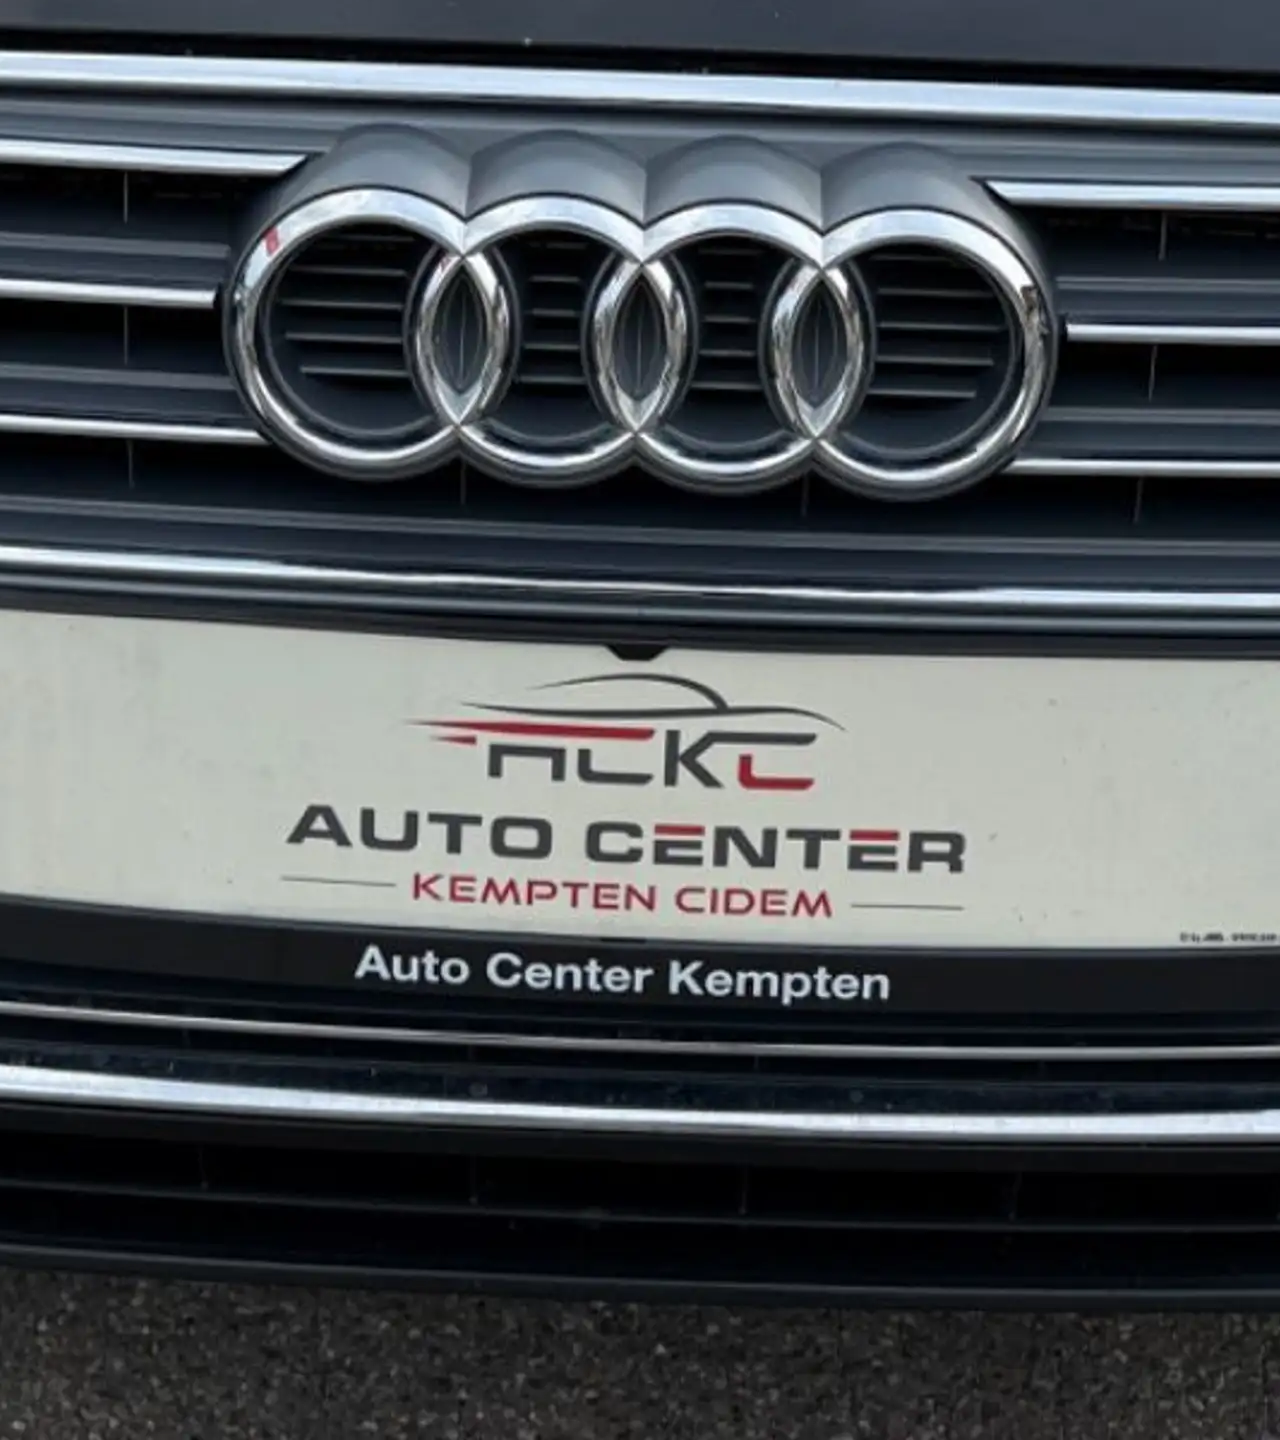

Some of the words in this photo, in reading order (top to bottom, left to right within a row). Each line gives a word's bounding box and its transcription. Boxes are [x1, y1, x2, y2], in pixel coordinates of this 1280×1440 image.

[285, 802, 553, 861] AUTO
[584, 820, 967, 874] CENTER
[412, 872, 656, 912] KEMPTEN
[674, 886, 833, 919] CIDEM
[354, 944, 471, 985] Auto
[485, 951, 655, 994] Center
[667, 960, 891, 1007] Kempten
